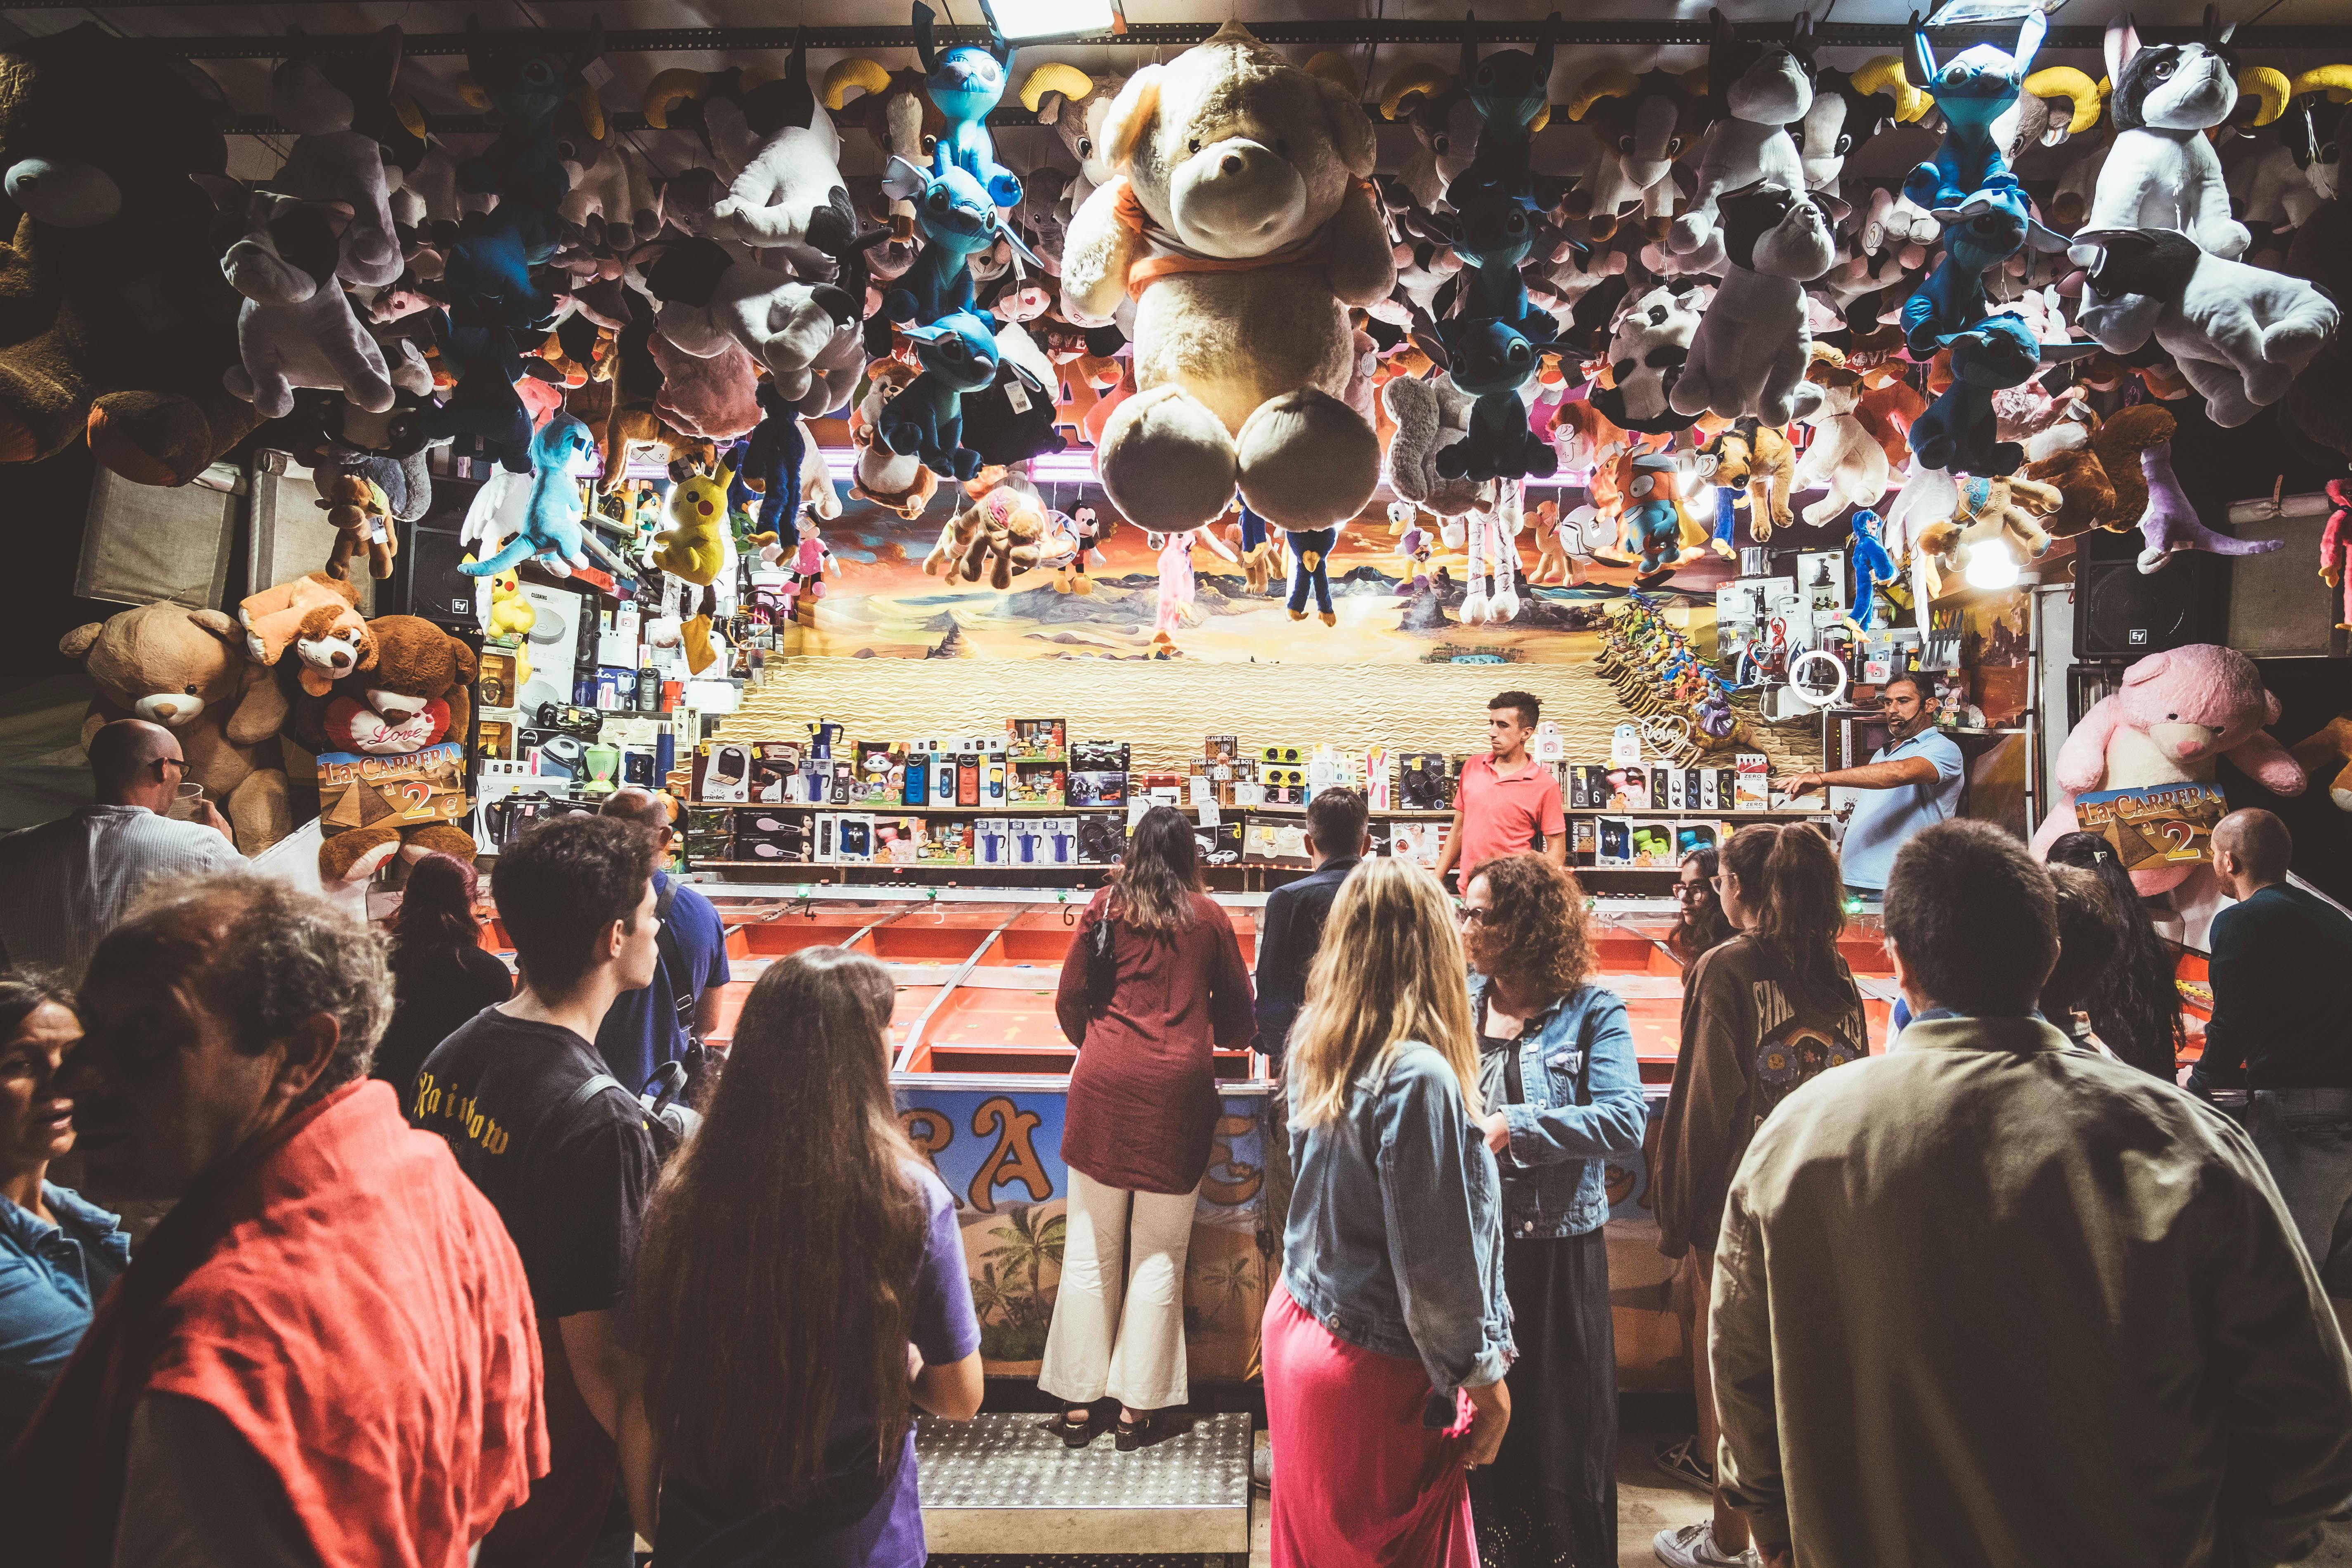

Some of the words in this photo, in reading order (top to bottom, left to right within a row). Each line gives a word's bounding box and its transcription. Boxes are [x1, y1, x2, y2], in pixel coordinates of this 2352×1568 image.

[531, 592, 547, 601] CLEANING
[367, 725, 423, 745] Love
[488, 746, 494, 754] 2
[754, 748, 760, 757] 2
[322, 762, 353, 786] La
[357, 746, 459, 781] CARRERA
[1414, 760, 1420, 769] 2
[1579, 769, 1585, 778] 2
[383, 781, 396, 796] a
[402, 781, 435, 819] 2
[440, 797, 459, 817] €
[835, 788, 843, 799] 6
[1576, 792, 1584, 803] 6
[1593, 791, 1600, 803] 6
[2078, 801, 2111, 826] La
[2113, 785, 2221, 820] CARRERA
[2141, 818, 2155, 836] a
[2162, 821, 2201, 861] 2
[803, 901, 816, 921] 4
[932, 902, 945, 925] 5
[1063, 905, 1074, 926] 6
